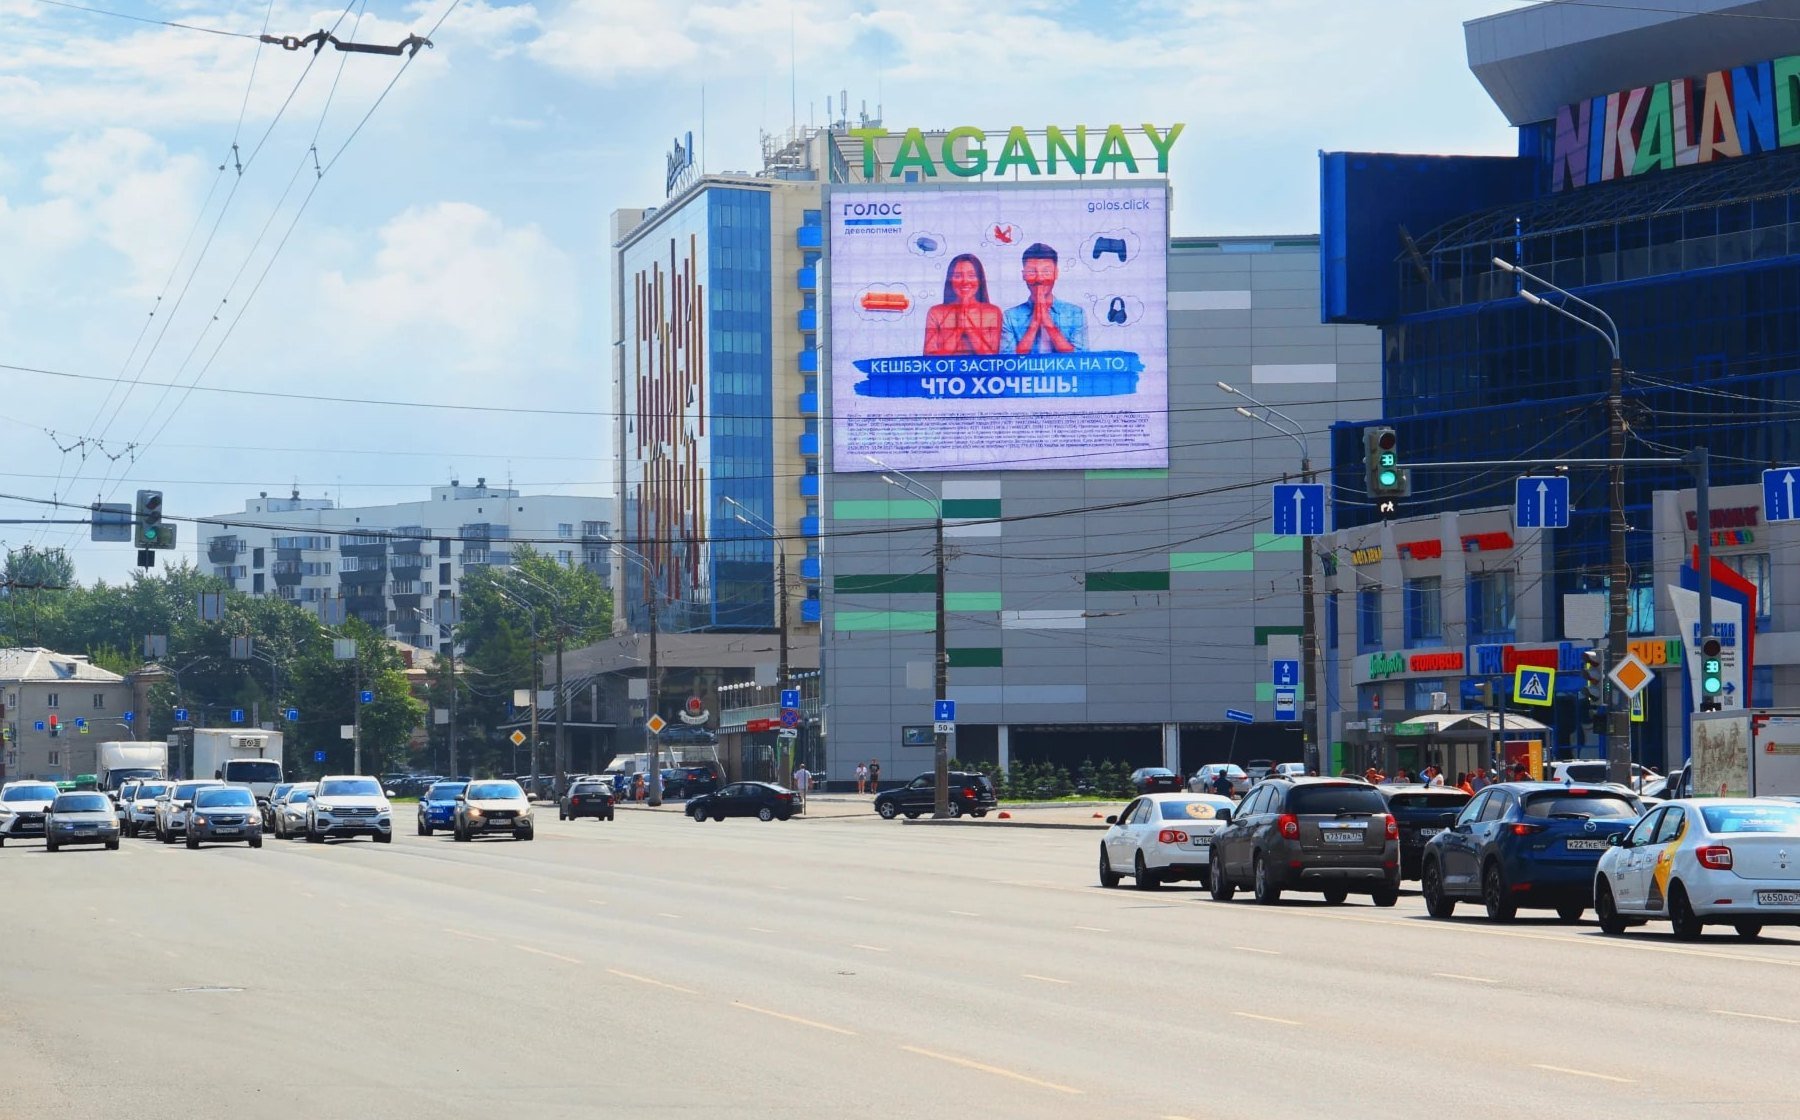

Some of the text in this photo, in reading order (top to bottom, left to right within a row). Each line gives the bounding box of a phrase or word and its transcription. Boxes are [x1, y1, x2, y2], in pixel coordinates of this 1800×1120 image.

[848, 123, 1186, 178] TAGANAY
[844, 203, 903, 216] ГОЛОС
[1087, 199, 1150, 213] golos.click
[844, 226, 903, 235] девелопмент
[871, 356, 1129, 374] КЕШБЭК ОТ ЗАСТРОЙЩИКА НА ТО,
[921, 377, 1078, 395] ЧТО ХОЧЕШЬ!
[1694, 623, 1735, 637] РСИЯ
[1476, 645, 1503, 674] ТРК
[938, 724, 948, 732] 50
